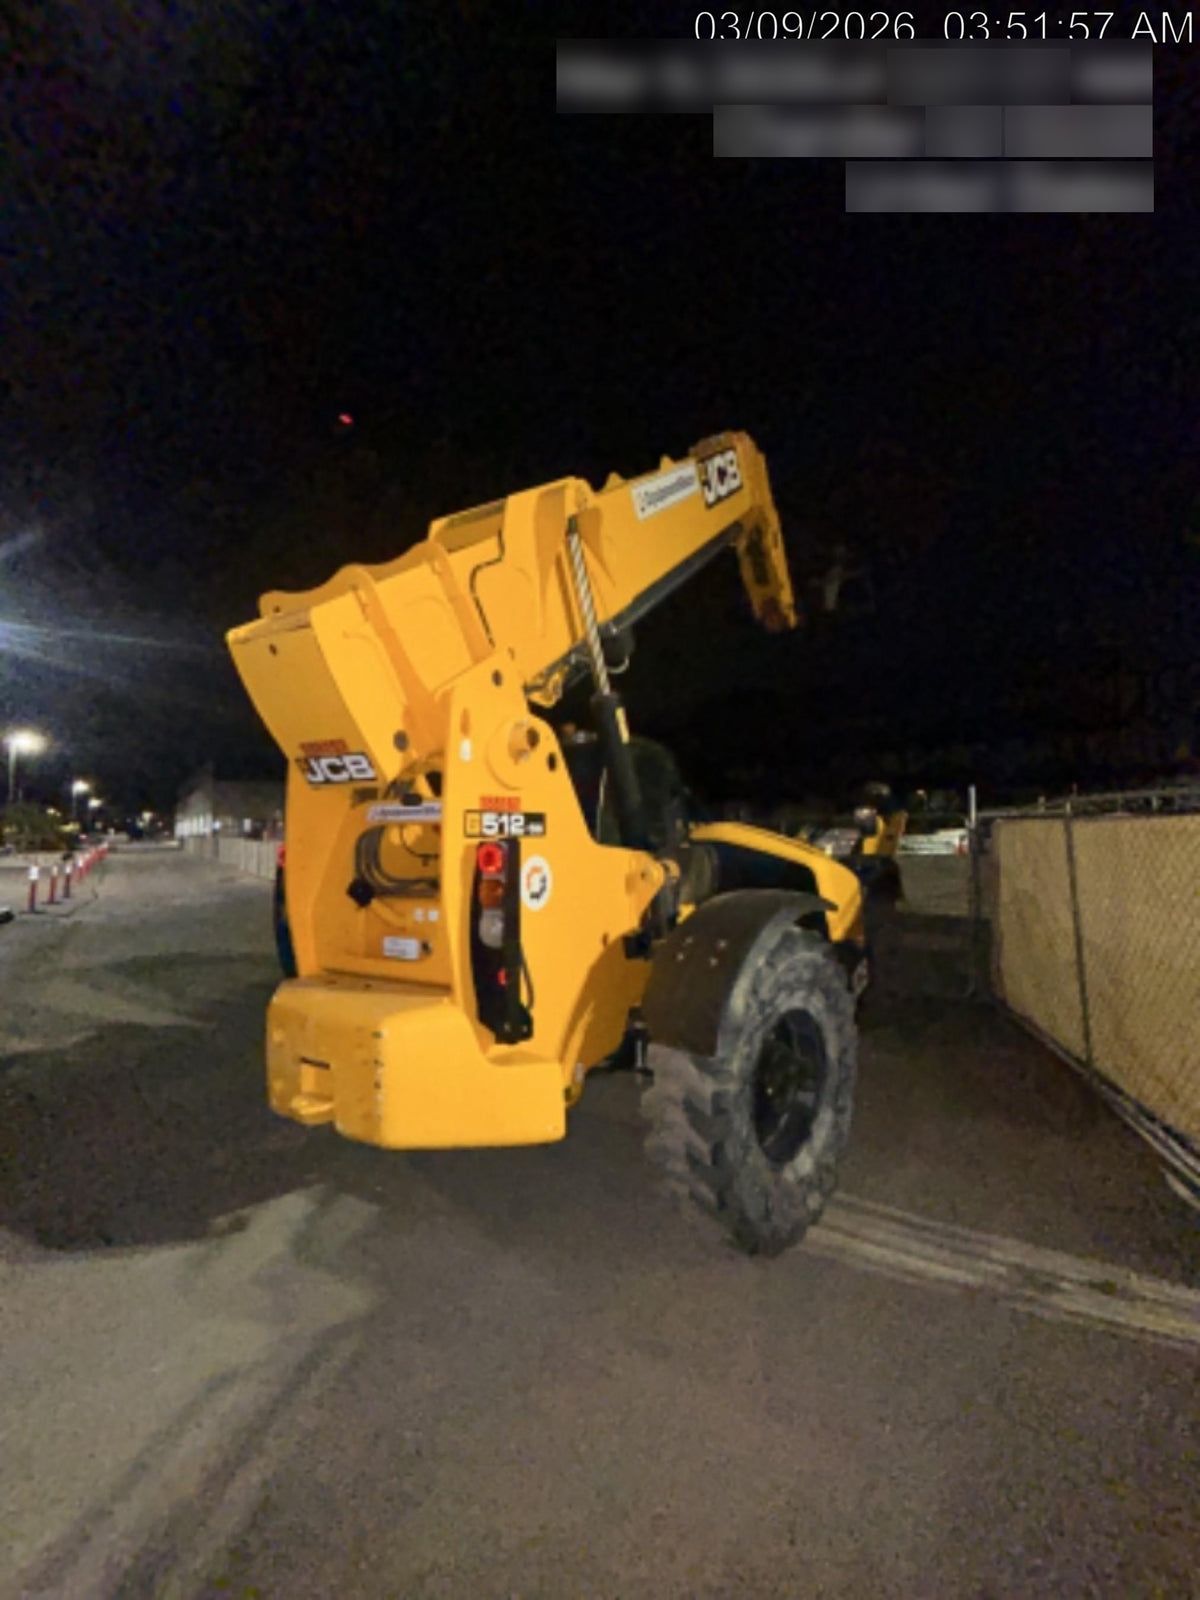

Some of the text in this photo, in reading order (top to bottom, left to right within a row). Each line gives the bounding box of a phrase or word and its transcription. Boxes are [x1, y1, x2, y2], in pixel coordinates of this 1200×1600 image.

[704, 450, 742, 504] JCB
[306, 754, 376, 783] JCB
[482, 812, 525, 836] 512
